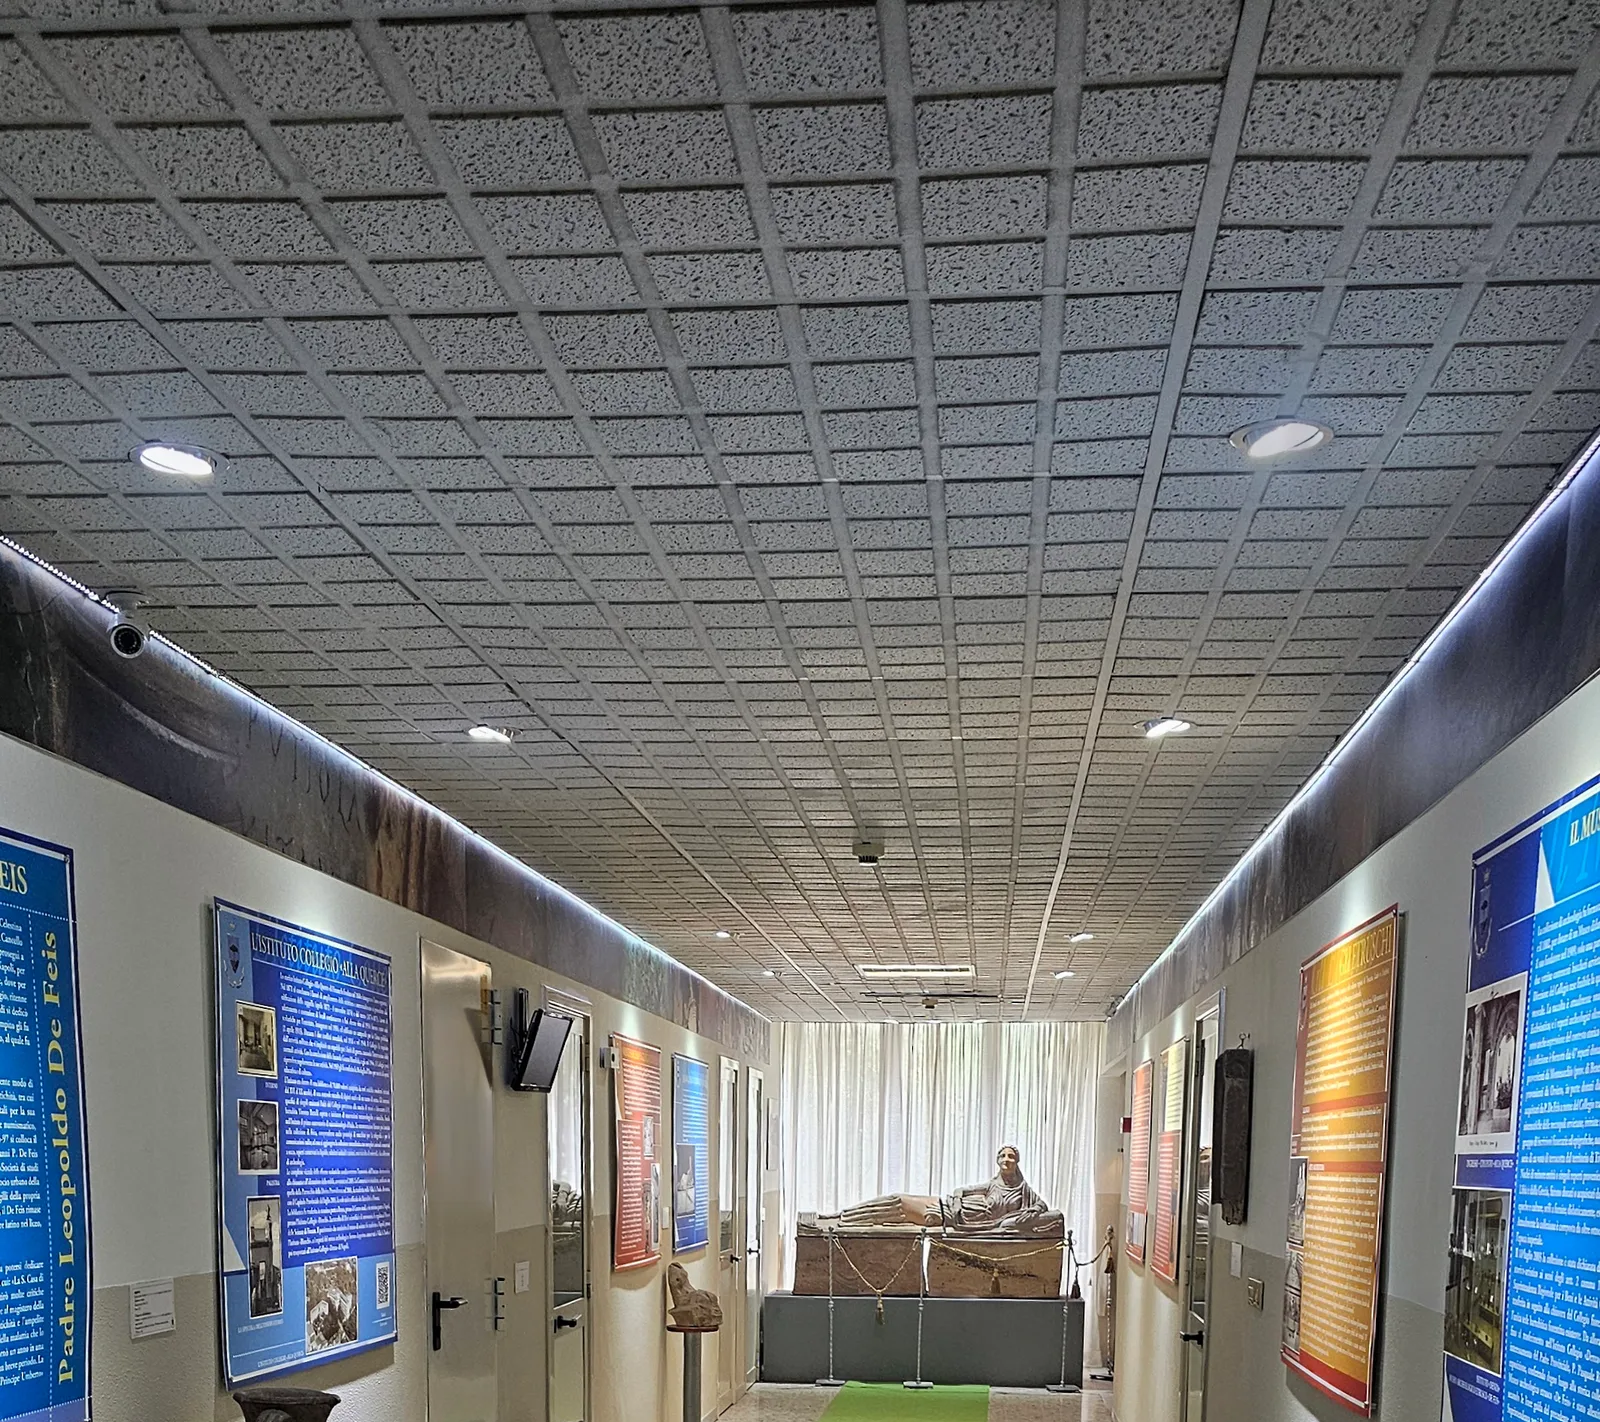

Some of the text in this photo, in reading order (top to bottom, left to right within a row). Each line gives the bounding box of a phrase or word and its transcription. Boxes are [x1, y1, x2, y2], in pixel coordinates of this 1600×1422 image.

[1569, 822, 1580, 847] IL
[1, 932, 23, 946] Cancello
[1352, 924, 1393, 969] ETRUSCHI
[299, 947, 339, 974] COLLEGIO
[16, 967, 25, 977] per
[4, 975, 26, 991] dove per
[10, 1034, 24, 1047] quale
[11, 1076, 26, 1087] modo
[27, 1078, 33, 1087] di
[9, 1108, 18, 1117] per
[15, 1134, 32, 1142] colloca
[18, 1147, 27, 1157] De
[27, 1147, 38, 1156] Feis
[42, 932, 77, 1385] Padre Leopoldo De Feis
[26, 1162, 39, 1171] studi
[10, 1175, 27, 1186] urbano
[28, 1174, 39, 1185] della
[9, 1190, 21, 1200] della
[22, 1190, 41, 1202] propria
[6, 1204, 14, 1214] De
[14, 1203, 25, 1214] Feis
[5, 1218, 19, 1228] latino
[20, 1218, 28, 1227] nel
[26, 1273, 38, 1283] Casa
[33, 1299, 44, 1311] della
[30, 1327, 38, 1337] che
[17, 1346, 29, 1354] anno
